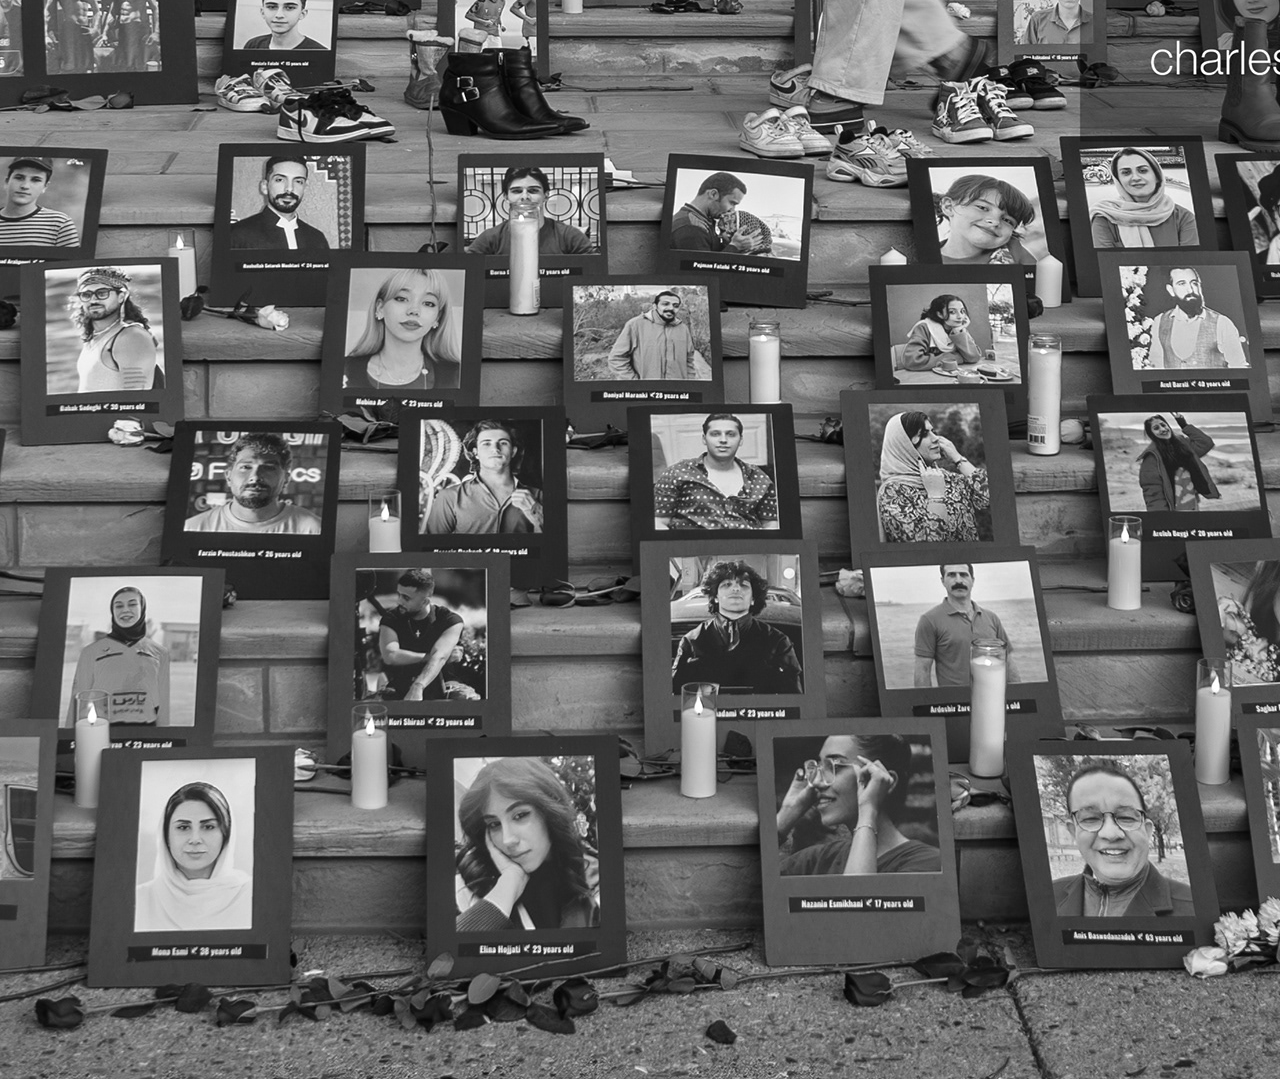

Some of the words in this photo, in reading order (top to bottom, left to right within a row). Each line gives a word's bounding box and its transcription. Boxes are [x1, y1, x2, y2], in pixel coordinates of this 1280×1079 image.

[874, 899, 882, 908] 17
[903, 900, 914, 908] old
[480, 945, 496, 954] Elina
[532, 945, 542, 954] 23
[543, 947, 562, 955] years
[563, 945, 574, 953] old
